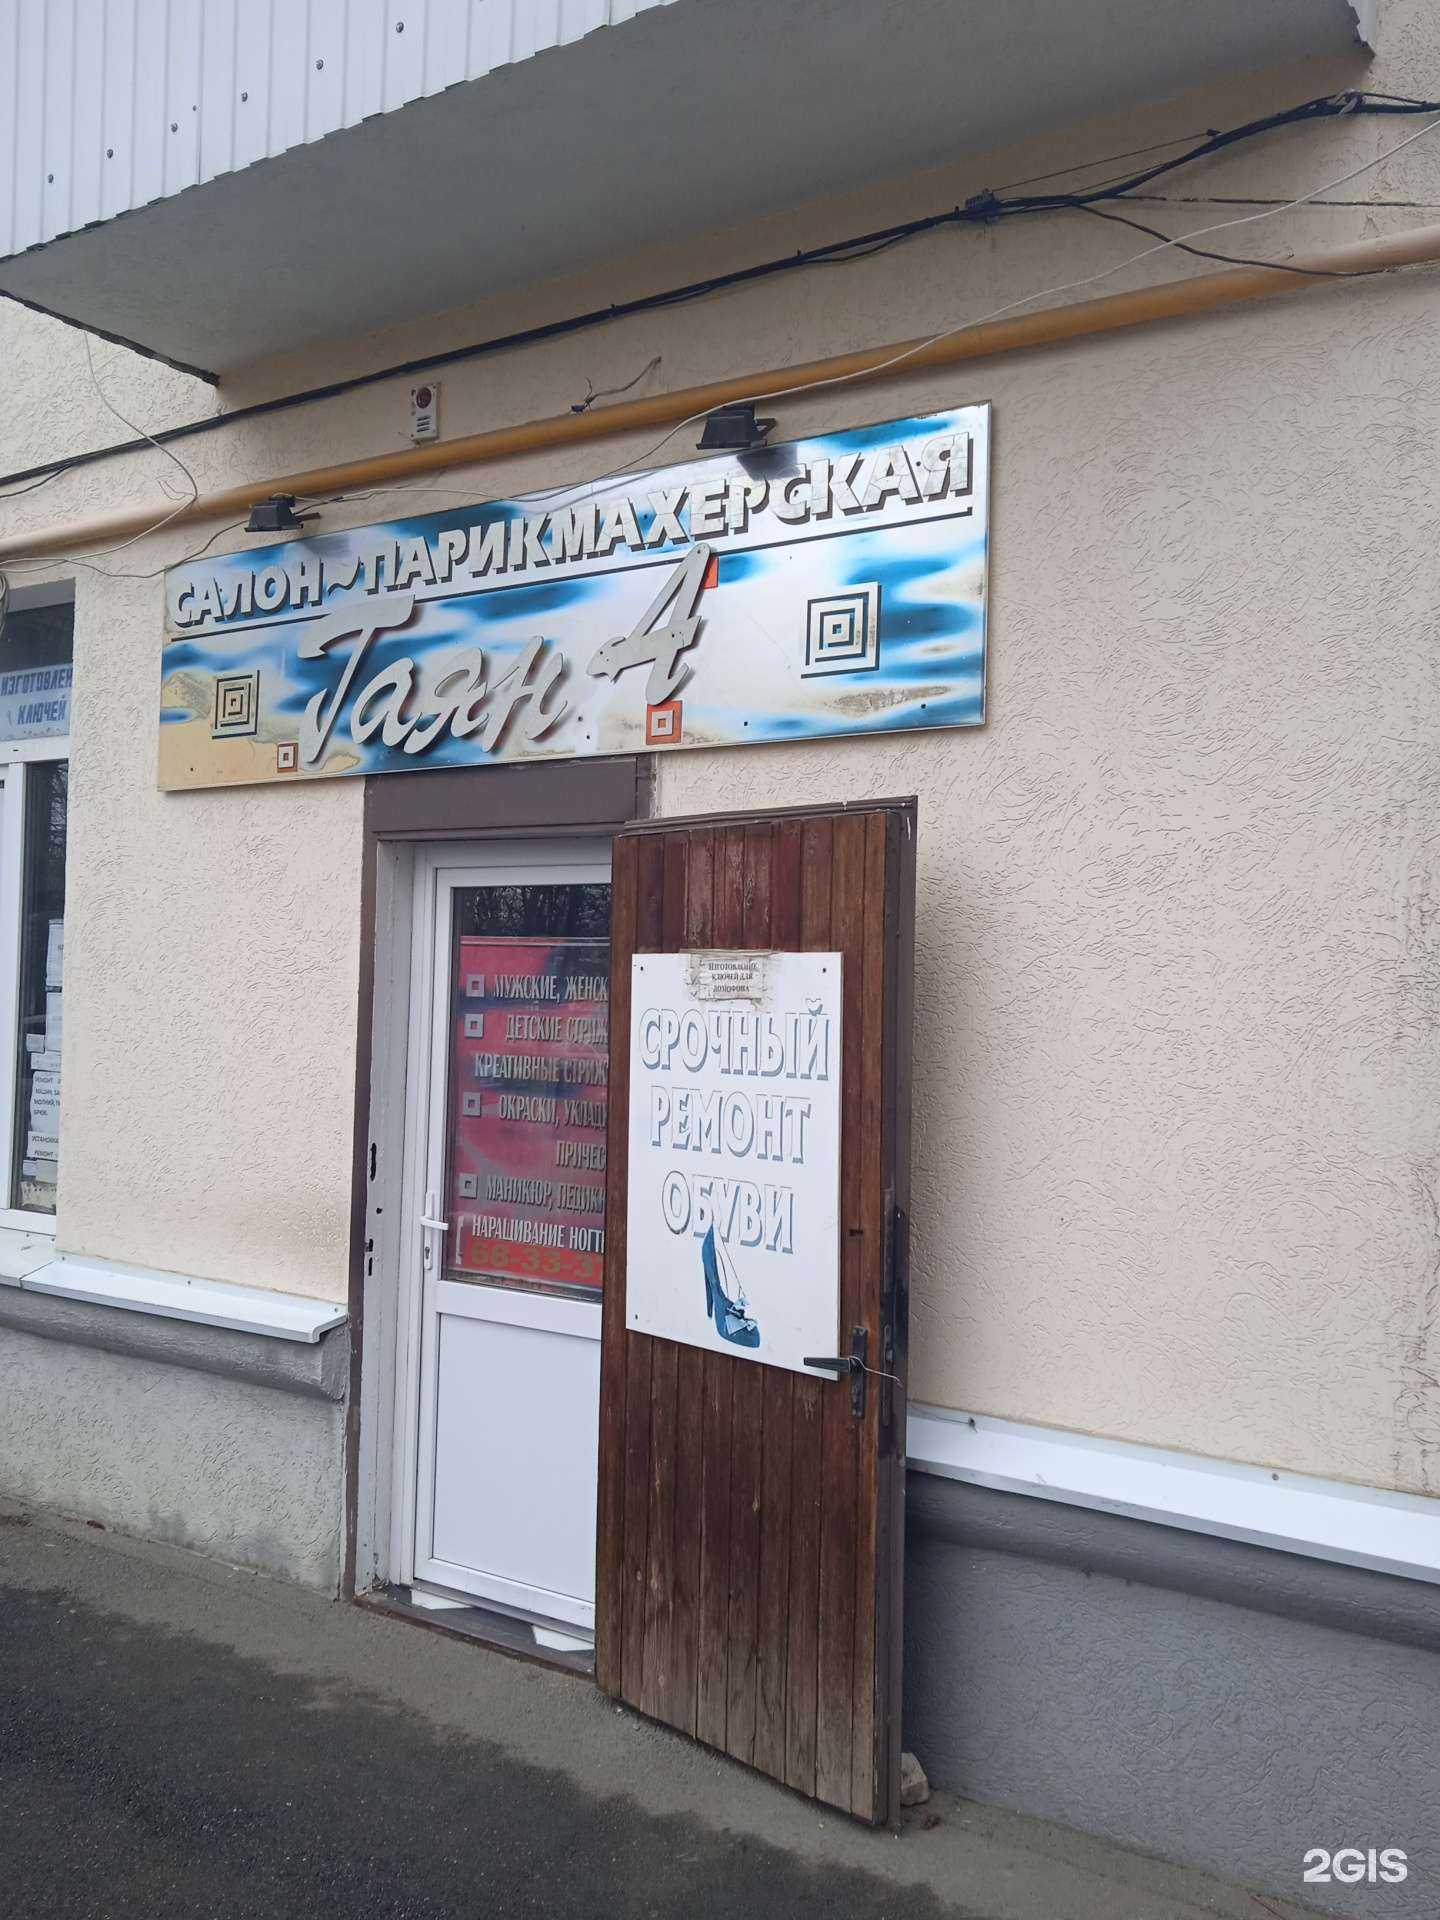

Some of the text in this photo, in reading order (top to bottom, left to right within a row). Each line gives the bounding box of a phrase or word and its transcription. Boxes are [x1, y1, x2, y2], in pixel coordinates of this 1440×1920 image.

[17, 694, 67, 725] КЛЮЧЕЙ
[494, 974, 560, 1003] МУЖСКИЕ,
[506, 1014, 562, 1042] ДЕТСКИЕ
[639, 998, 830, 1081] СРОЧНЫЙ
[475, 1053, 559, 1083] КРЕАТИВНЫЕ
[499, 1094, 559, 1127] ОКРАСКИ,
[650, 1085, 811, 1165] РЕМОНТ
[487, 1176, 552, 1211] МАНИКЮР,
[661, 1170, 794, 1254] ОБУВИ
[472, 1214, 566, 1248] НАРАЩИВАНИЕ
